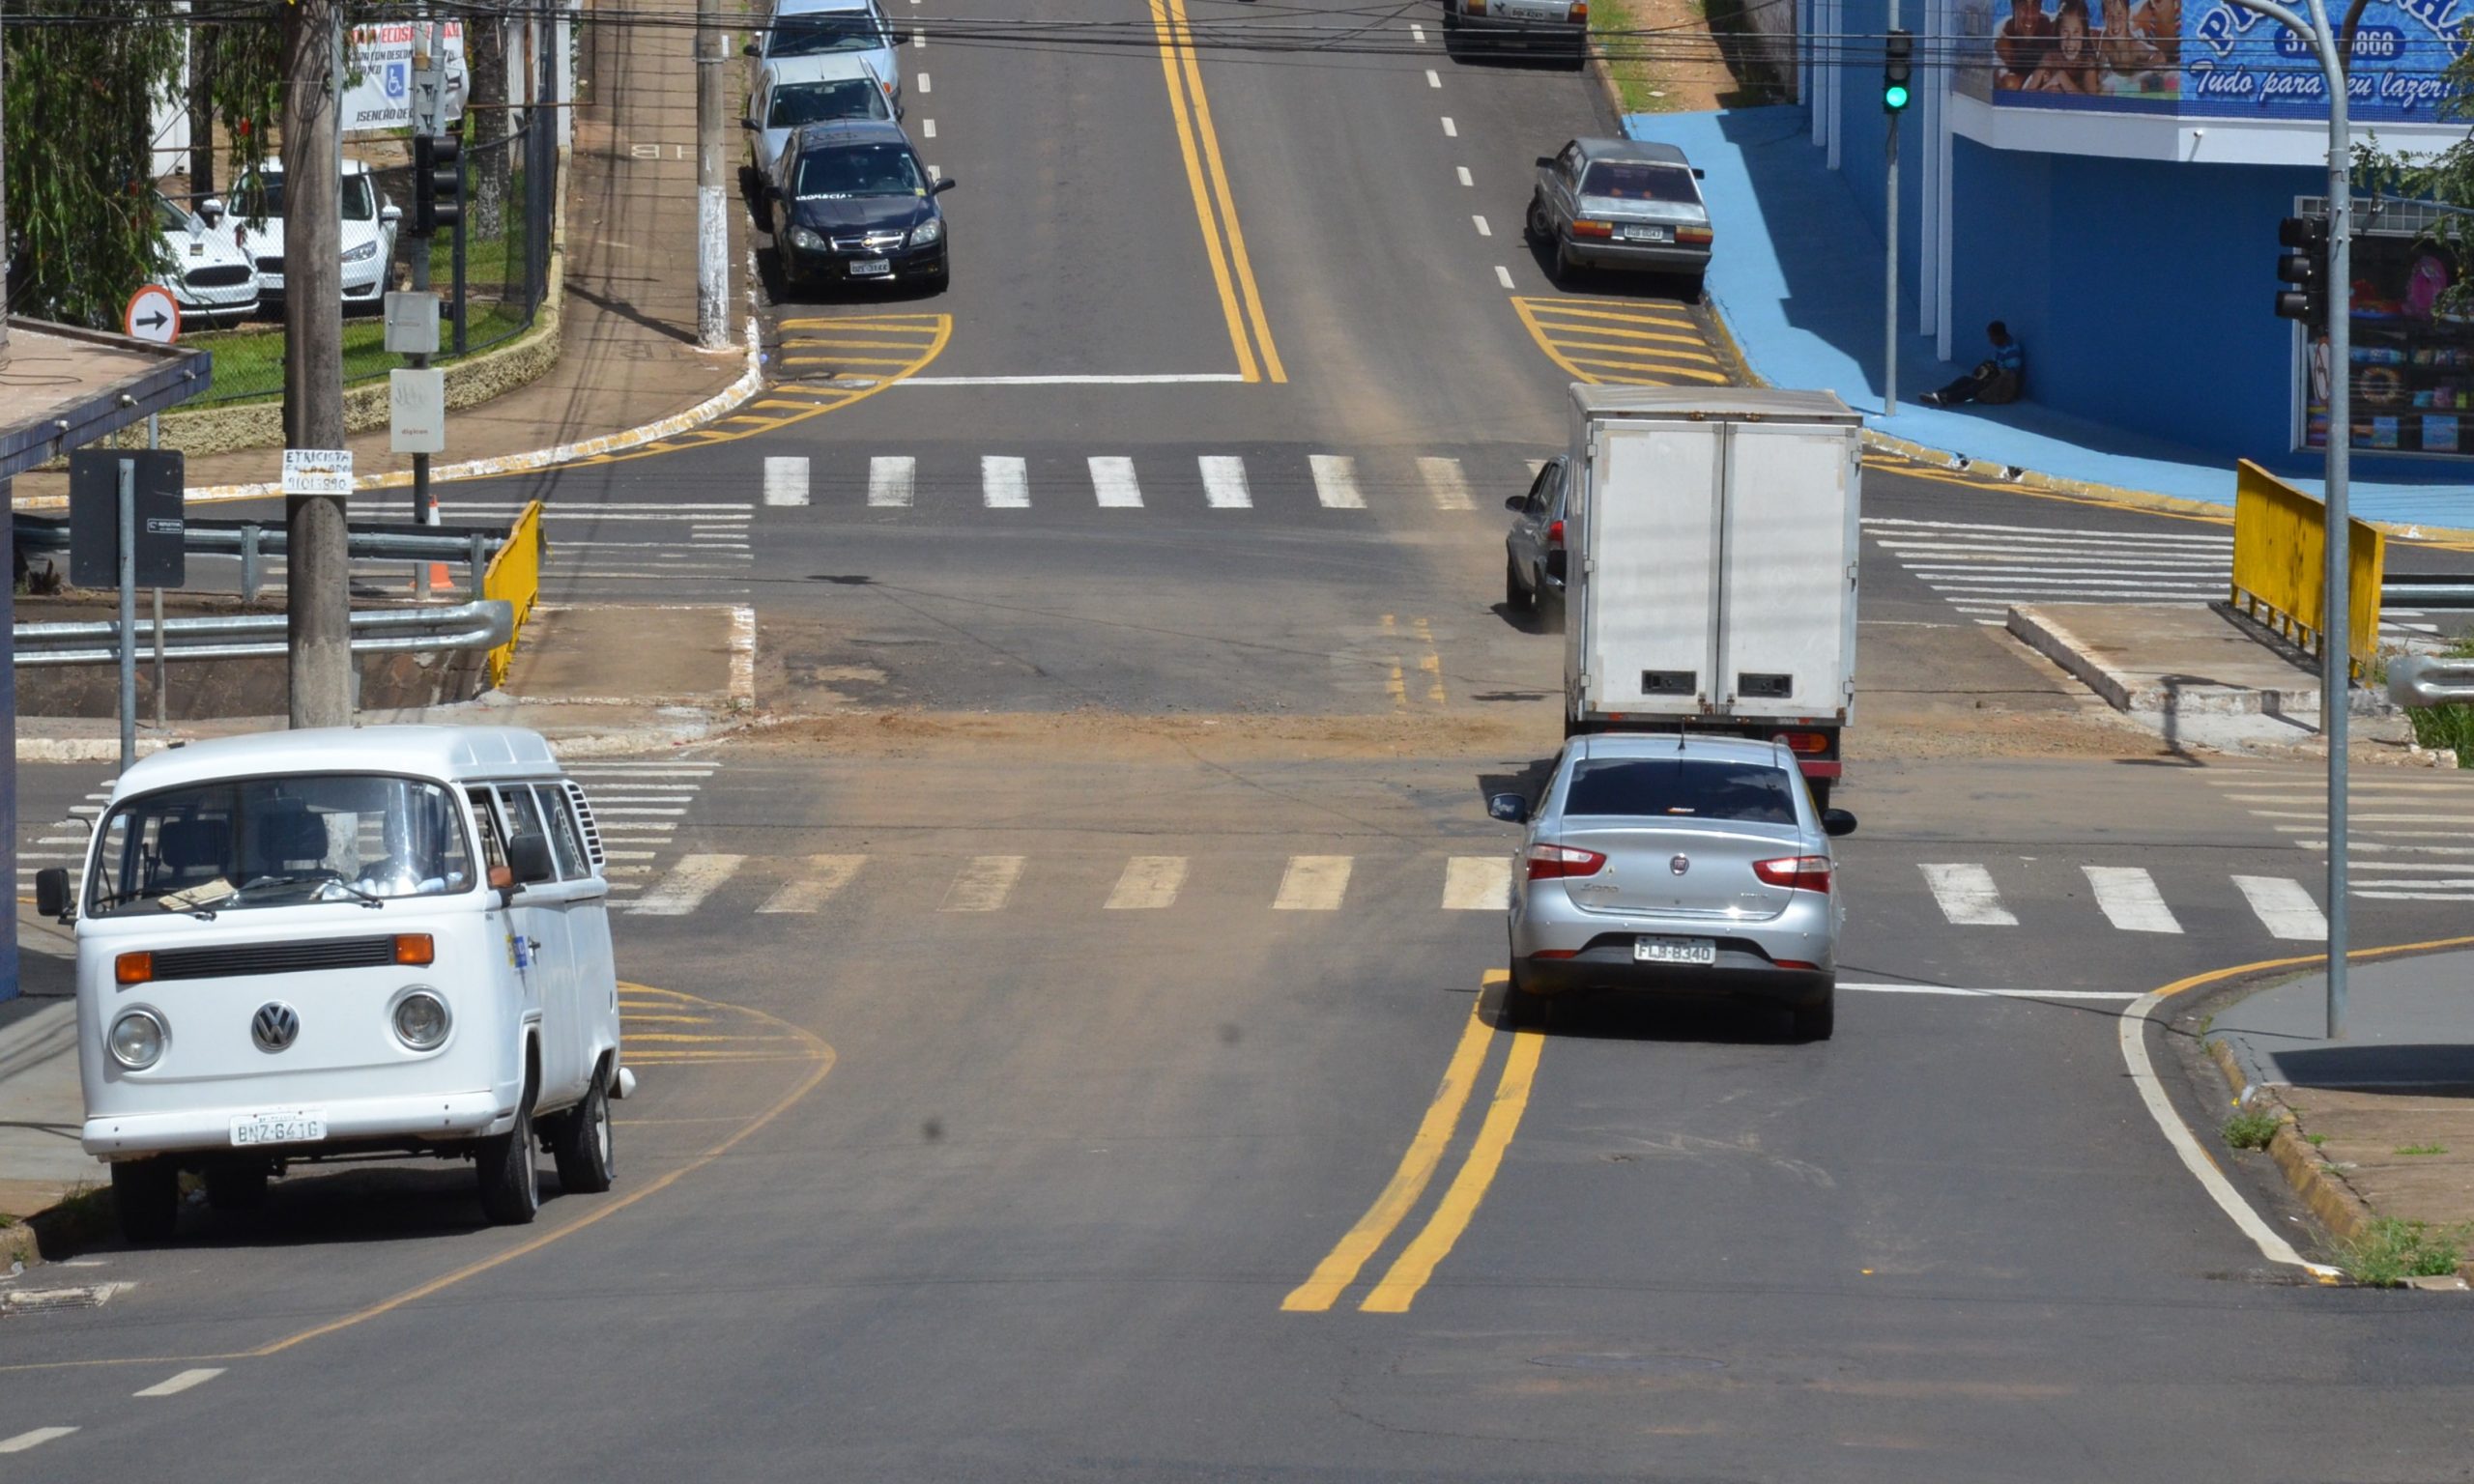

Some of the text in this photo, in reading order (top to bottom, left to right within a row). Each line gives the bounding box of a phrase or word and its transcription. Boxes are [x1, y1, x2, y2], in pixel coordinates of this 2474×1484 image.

[2351, 30, 2394, 55] 868
[2189, 60, 2254, 94] Tudo
[2258, 71, 2322, 101] para
[2347, 77, 2373, 96] eu
